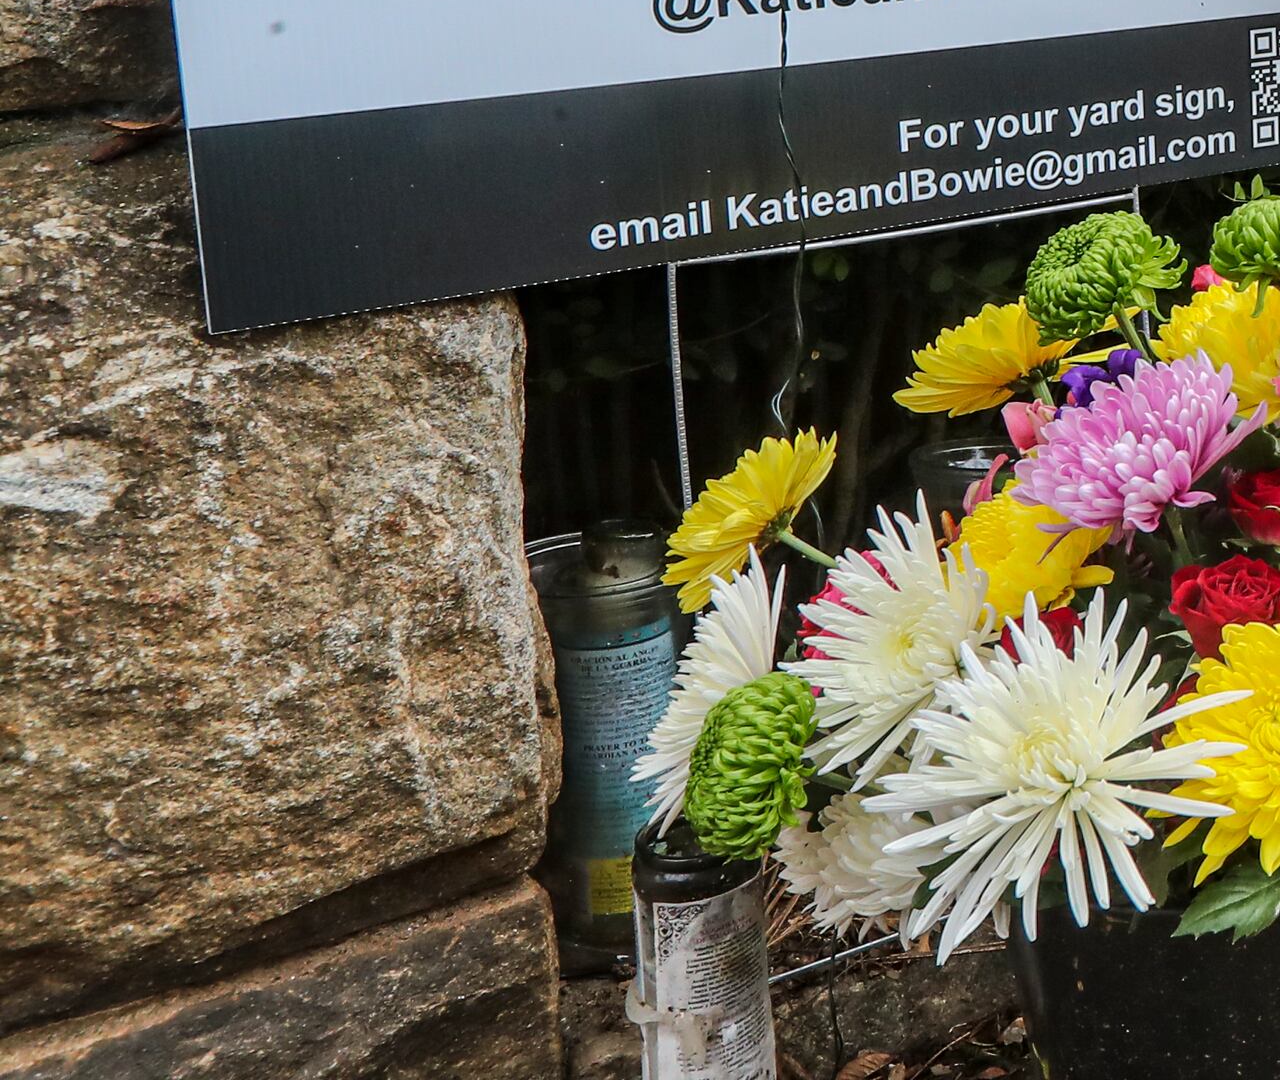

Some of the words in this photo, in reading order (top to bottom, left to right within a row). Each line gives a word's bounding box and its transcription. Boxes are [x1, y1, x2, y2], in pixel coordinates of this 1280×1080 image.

[900, 119, 964, 152] For
[975, 109, 1058, 150] your
[1068, 90, 1144, 136] yard
[1156, 85, 1234, 119] sign,
[591, 200, 711, 249] email
[727, 127, 1236, 232] KatieandBowie@gmail.com
